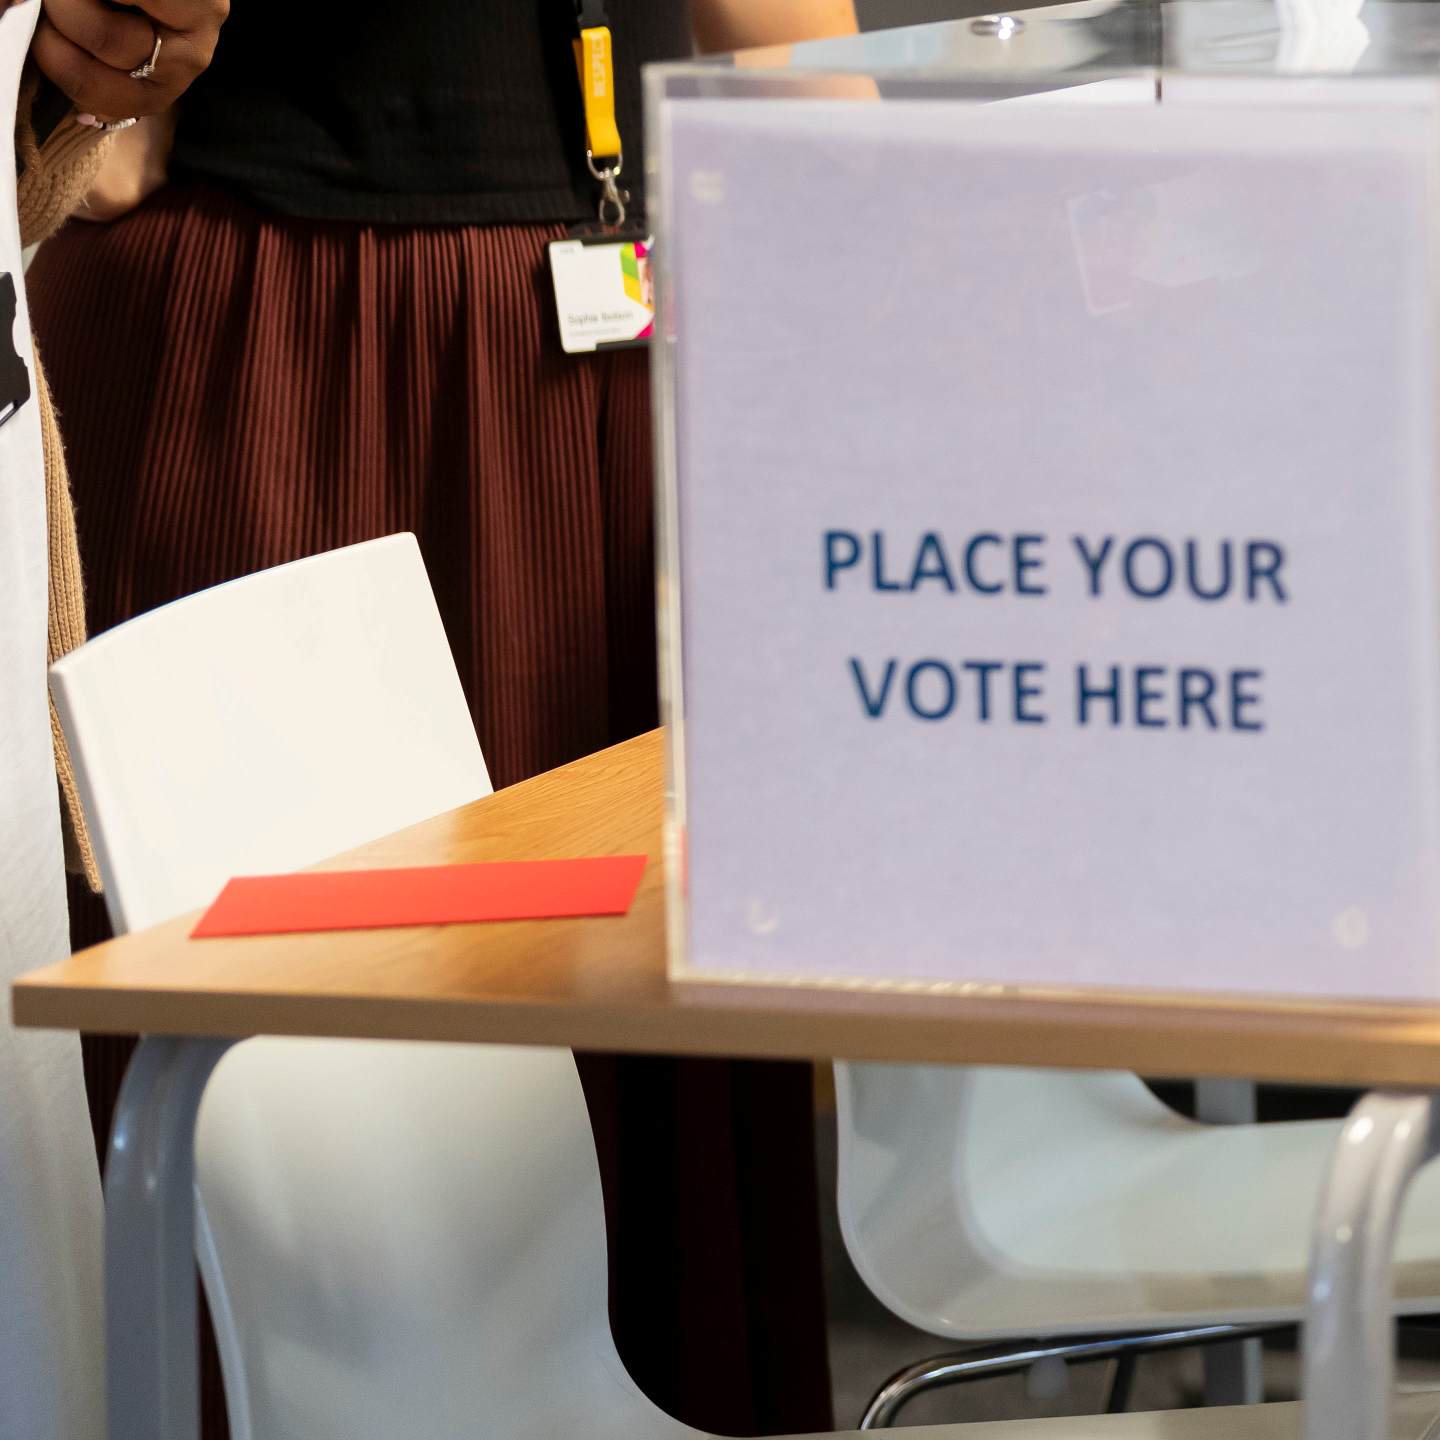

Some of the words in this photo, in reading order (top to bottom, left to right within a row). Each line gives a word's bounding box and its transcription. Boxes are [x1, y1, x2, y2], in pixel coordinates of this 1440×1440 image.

[822, 529, 1047, 595] PLACE
[1072, 535, 1288, 603] YOUR
[849, 658, 1047, 724] VOTE
[1075, 665, 1263, 731] HERE
